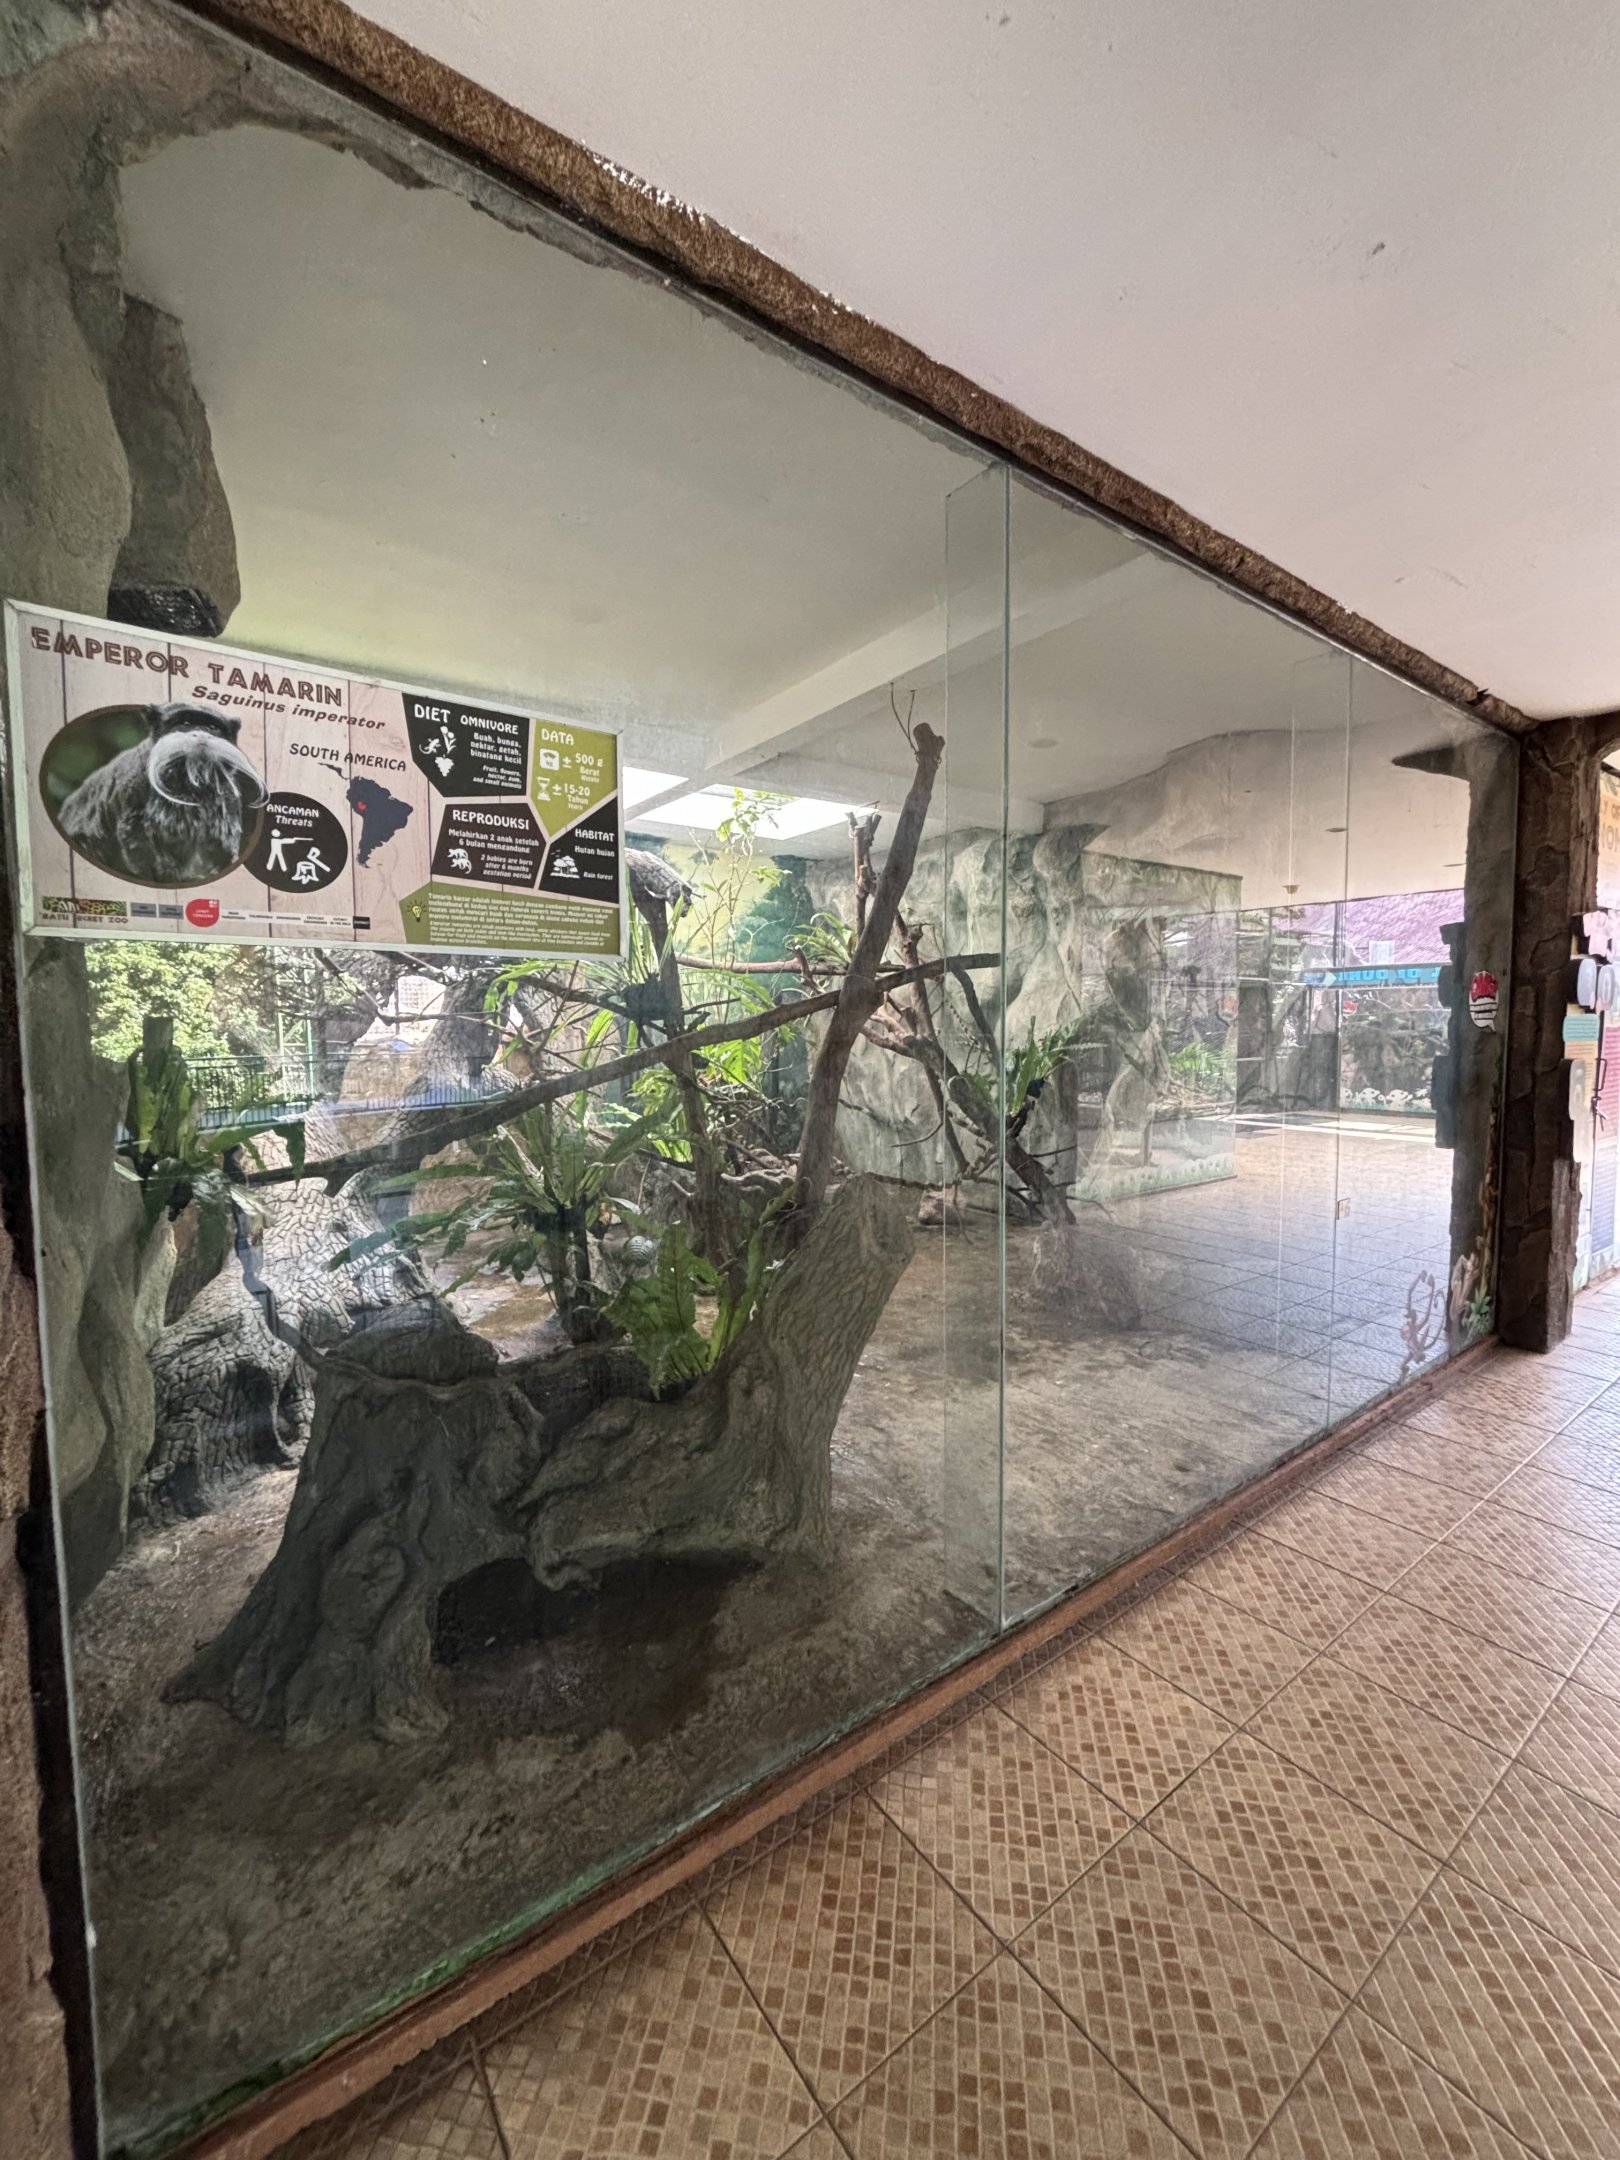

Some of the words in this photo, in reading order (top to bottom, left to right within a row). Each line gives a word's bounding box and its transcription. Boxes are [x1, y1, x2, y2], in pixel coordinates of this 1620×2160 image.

[31, 627, 189, 678] EMPEROR
[208, 662, 342, 707] TAMARIN
[192, 684, 286, 715] Saguinus
[292, 704, 385, 731] imperator
[414, 703, 451, 723] DIET
[460, 714, 518, 734] OMNIVORE
[541, 728, 574, 746] DATA
[290, 743, 339, 761] SOUTH
[344, 752, 407, 772] AMERICA
[470, 749, 502, 761] binatang
[504, 754, 521, 764] kecil
[575, 752, 594, 766] 500
[564, 783, 591, 797] 15-20
[266, 803, 320, 818] ANCAMAN
[276, 814, 313, 828] Threats
[452, 809, 529, 831] REPRODUKSI
[448, 828, 488, 841] Melahirkan
[490, 833, 495, 841] 2
[497, 835, 513, 844] anak
[515, 837, 540, 847] setelah
[575, 828, 615, 842] HABITAT
[466, 839, 485, 849] bulan
[487, 842, 531, 854] mengandung
[574, 845, 596, 855] Hutan
[42, 913, 69, 921] BATU
[74, 915, 104, 923] ECRET
[108, 916, 129, 924] ZOO
